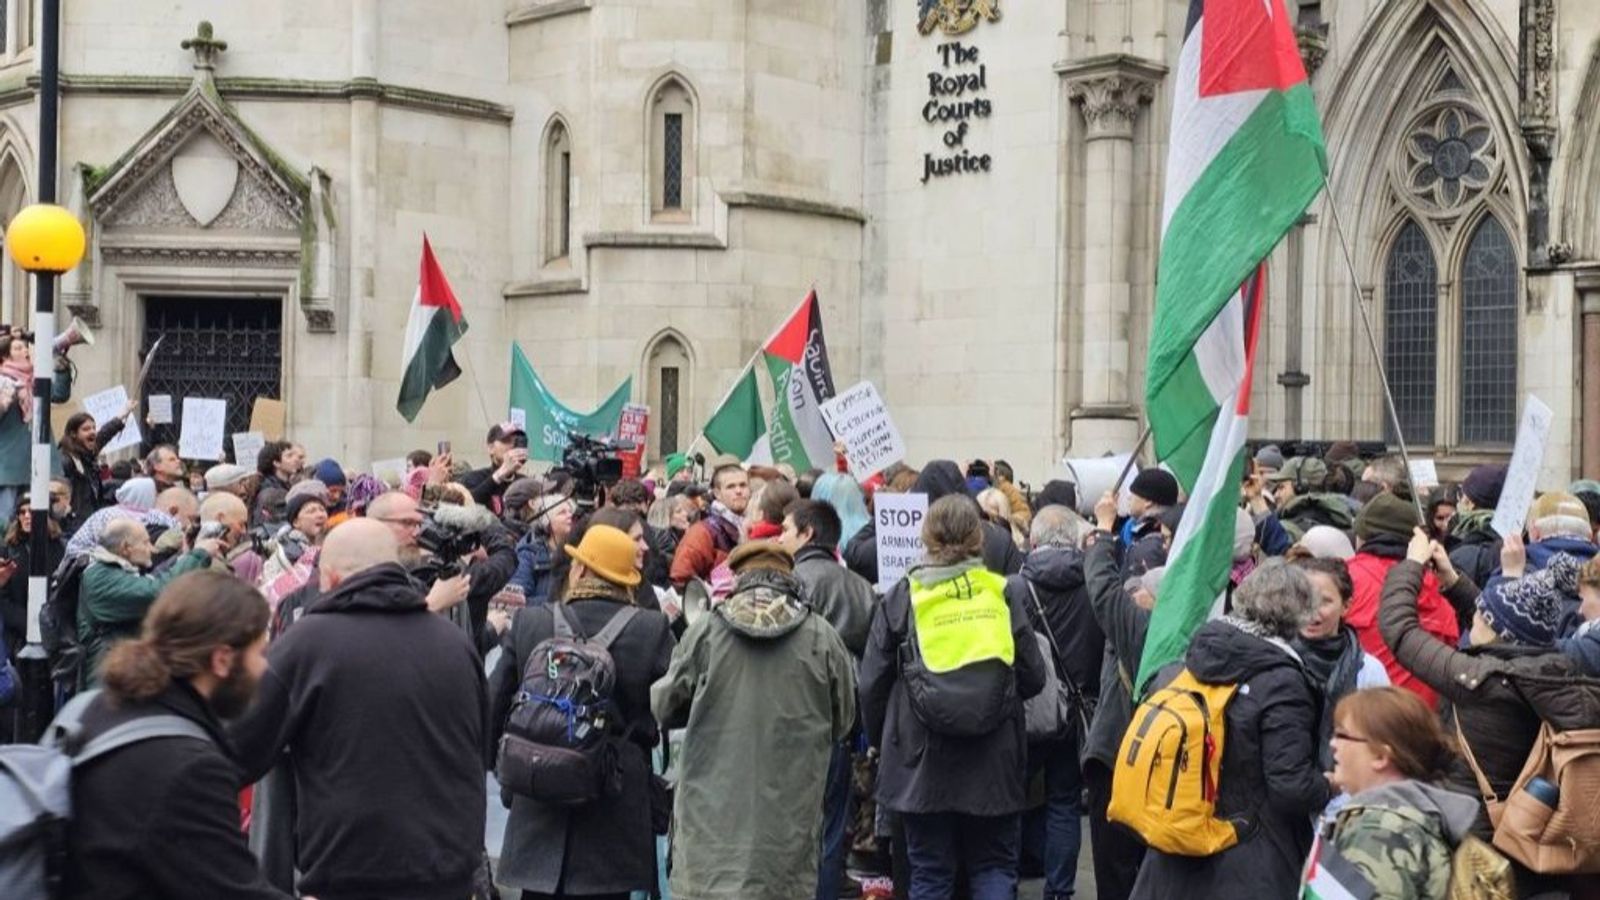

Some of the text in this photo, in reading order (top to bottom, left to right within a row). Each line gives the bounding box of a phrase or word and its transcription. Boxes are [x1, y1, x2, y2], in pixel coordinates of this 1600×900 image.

[937, 42, 979, 67] The
[927, 64, 986, 97] Royal
[922, 98, 992, 123] Courts
[943, 121, 968, 148] of
[920, 149, 992, 185] Justice
[880, 508, 922, 527] STOP
